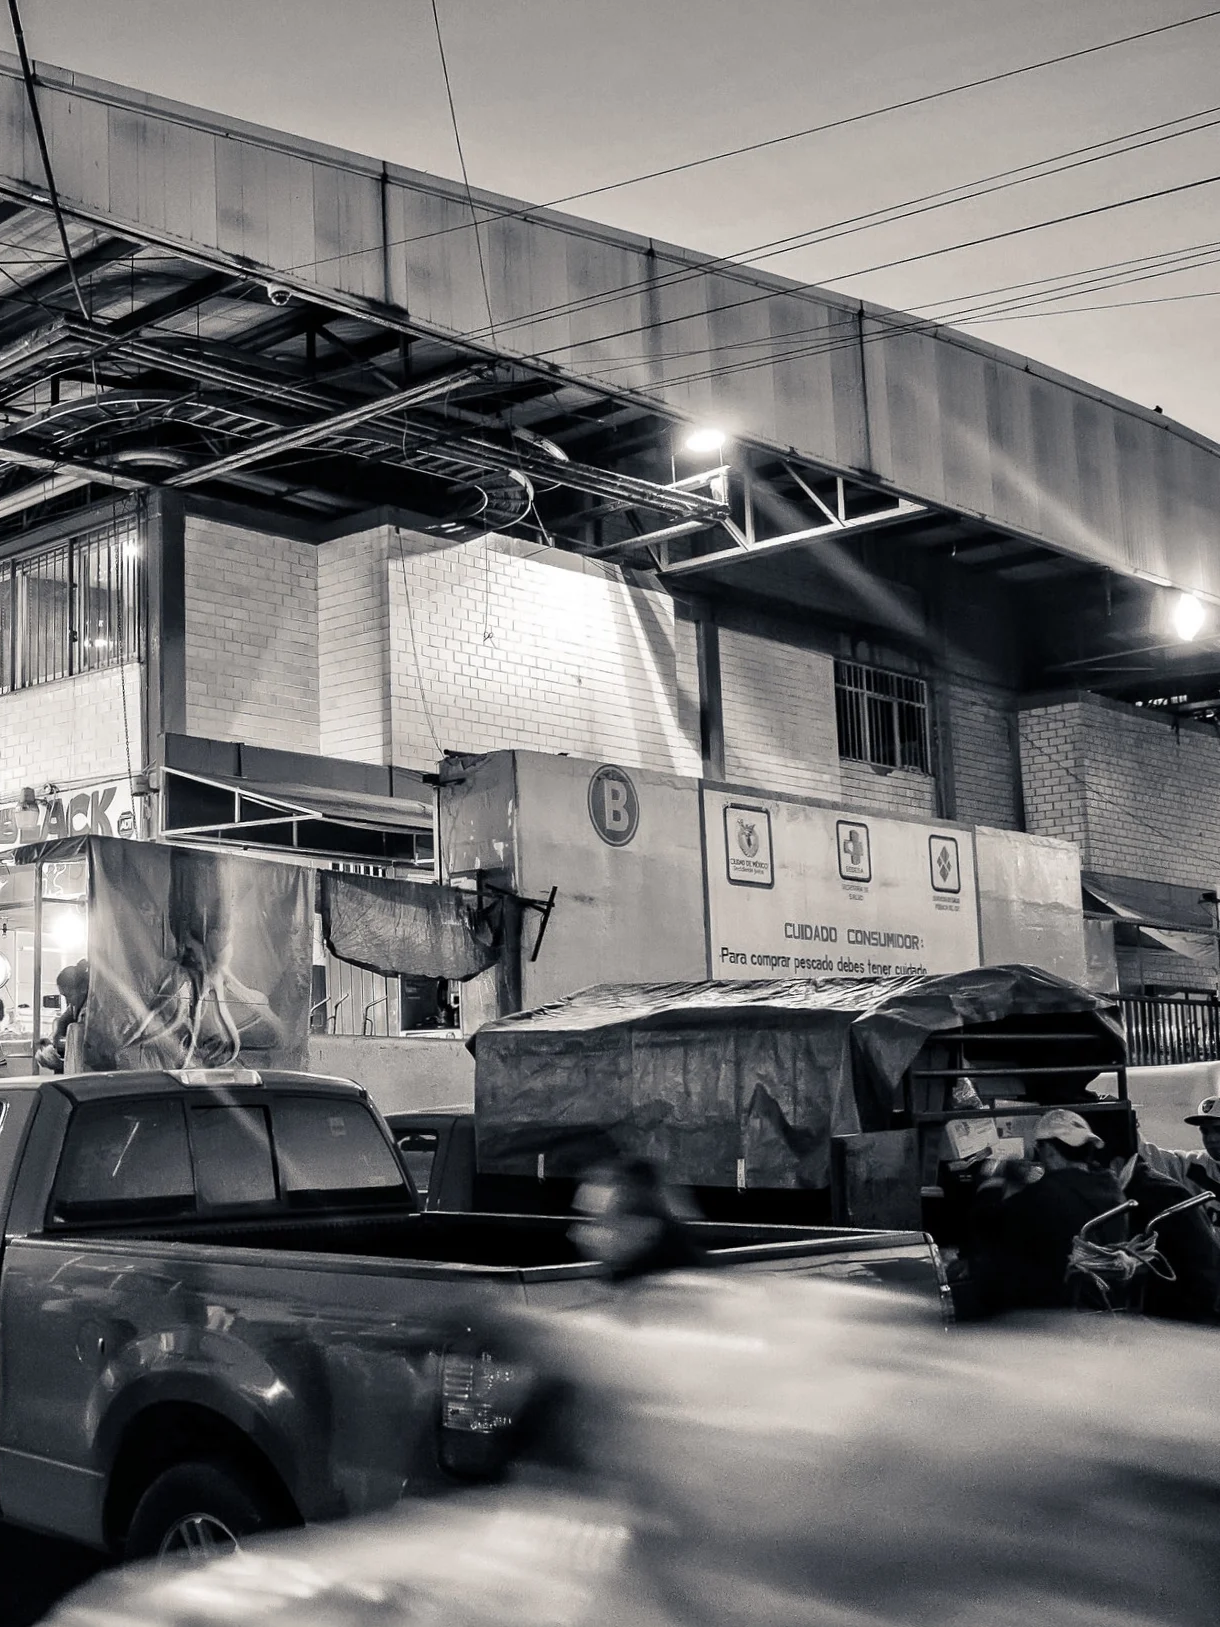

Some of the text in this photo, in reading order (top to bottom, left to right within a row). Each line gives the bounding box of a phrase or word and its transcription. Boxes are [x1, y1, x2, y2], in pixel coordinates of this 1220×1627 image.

[604, 780, 629, 832] B
[784, 922, 924, 951] CUIDADO CONSUMIDOR:
[720, 946, 748, 966] Para
[750, 952, 791, 971] comprar
[794, 954, 834, 974] pescado
[837, 958, 865, 974] debes
[867, 959, 892, 975] tener
